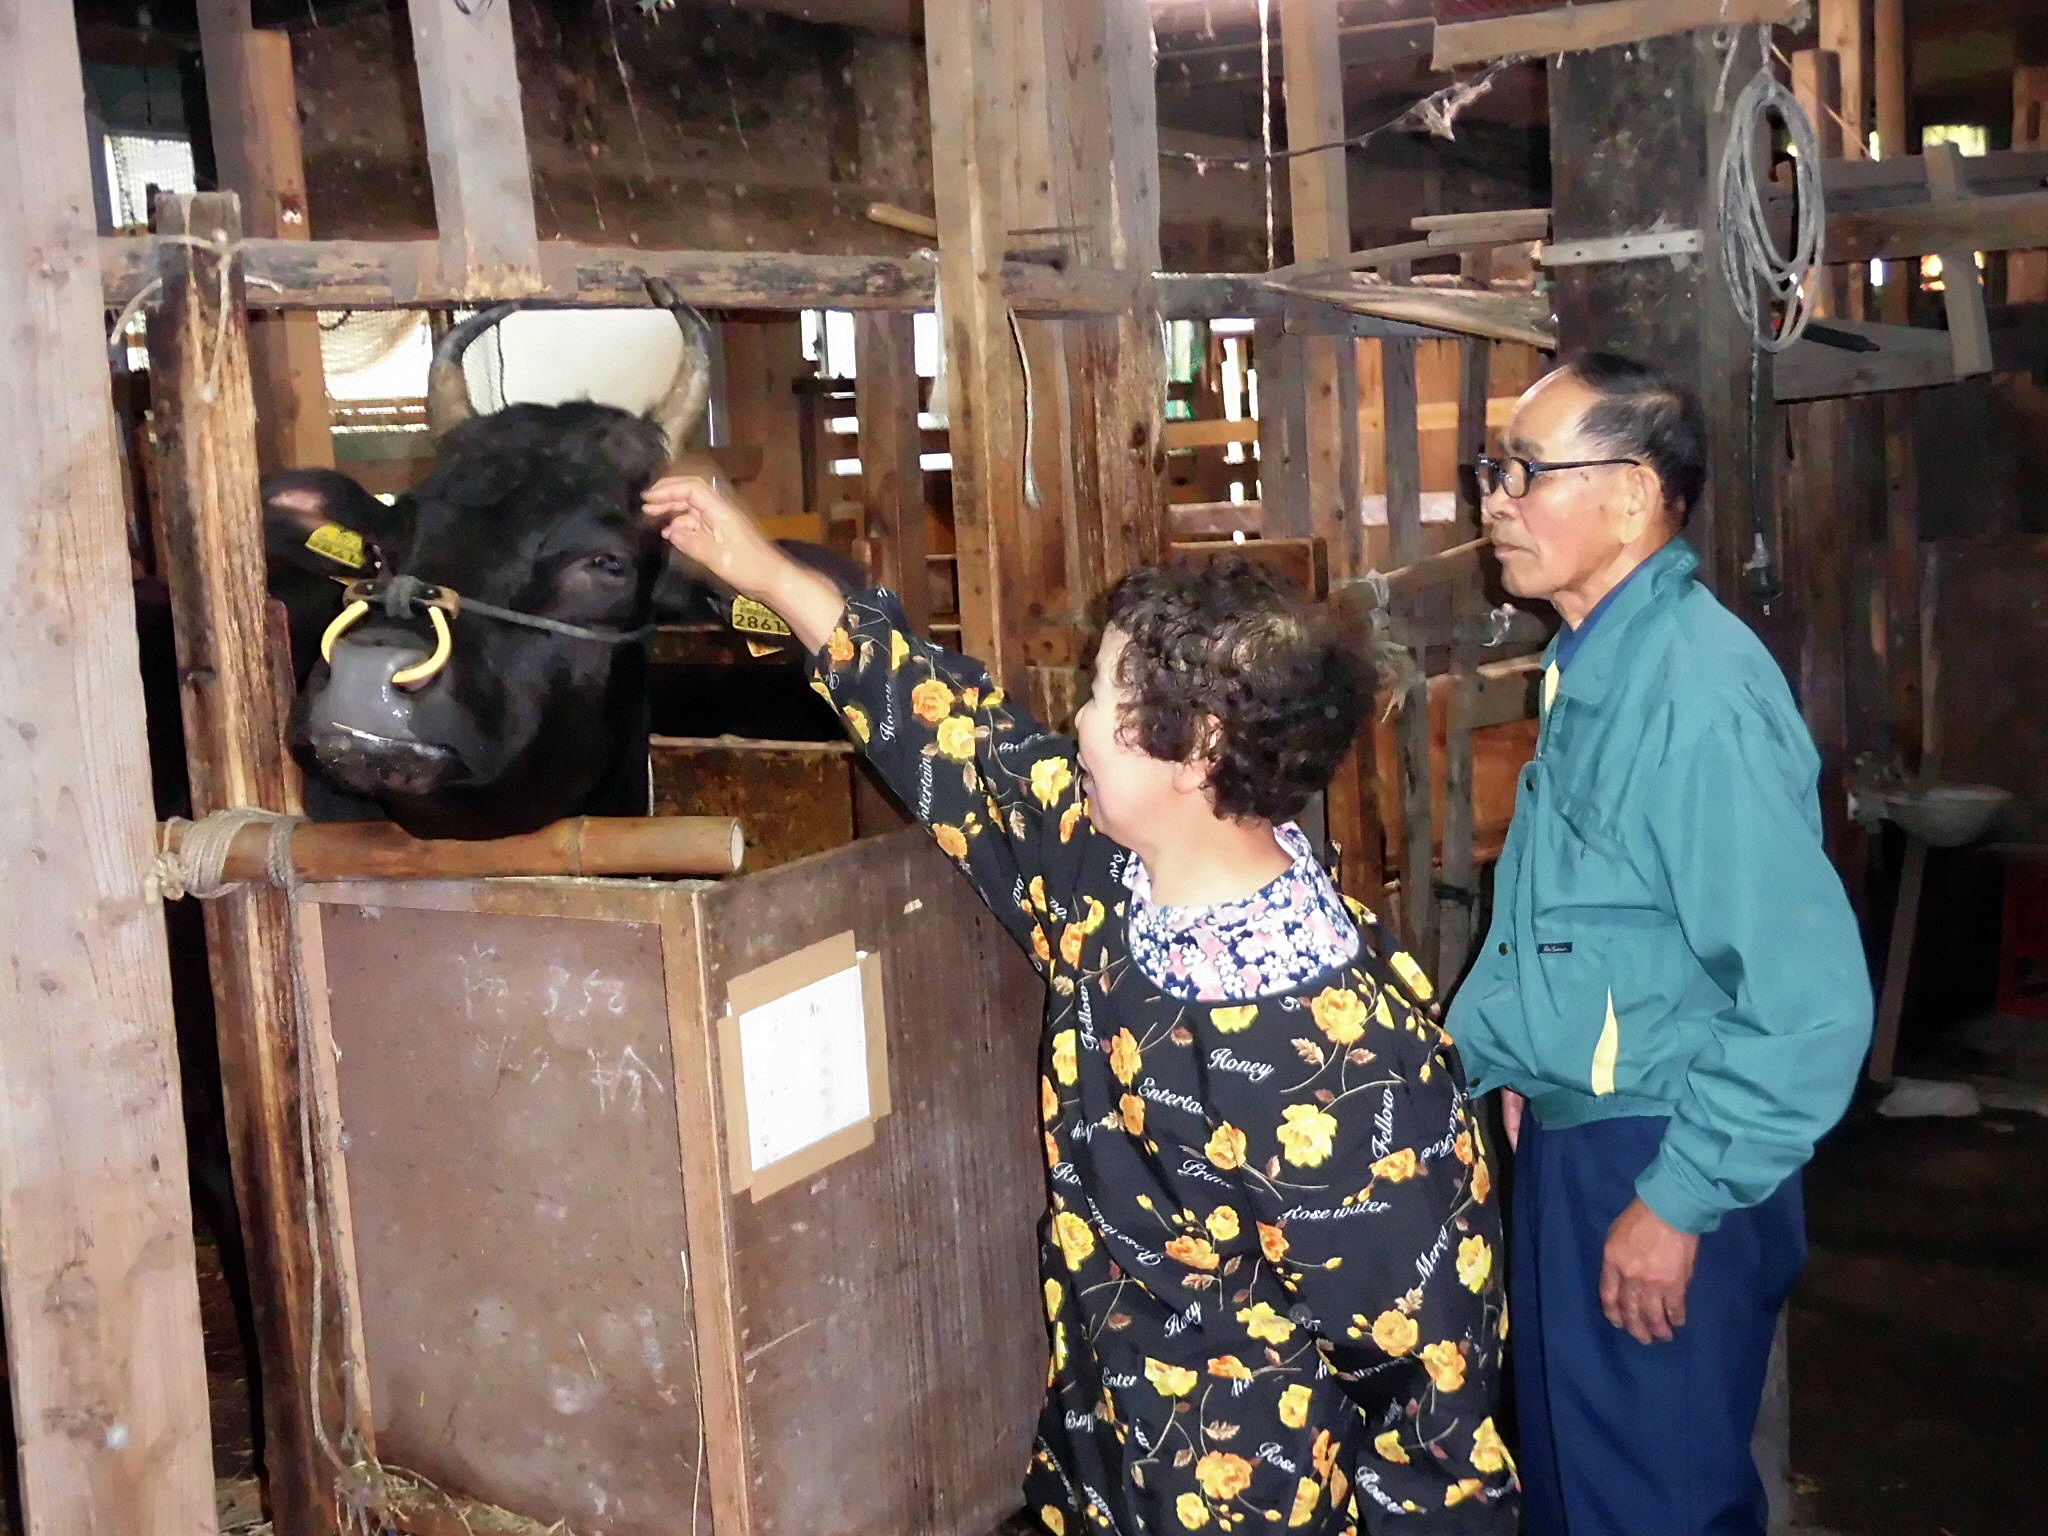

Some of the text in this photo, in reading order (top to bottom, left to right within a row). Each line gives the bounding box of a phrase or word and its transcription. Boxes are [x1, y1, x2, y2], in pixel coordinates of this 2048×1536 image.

[1207, 1048, 1275, 1082] Honey
[1372, 1082, 1395, 1158] Fellow
[1333, 1199, 1391, 1219] water
[1415, 1225, 1449, 1288] Mercy
